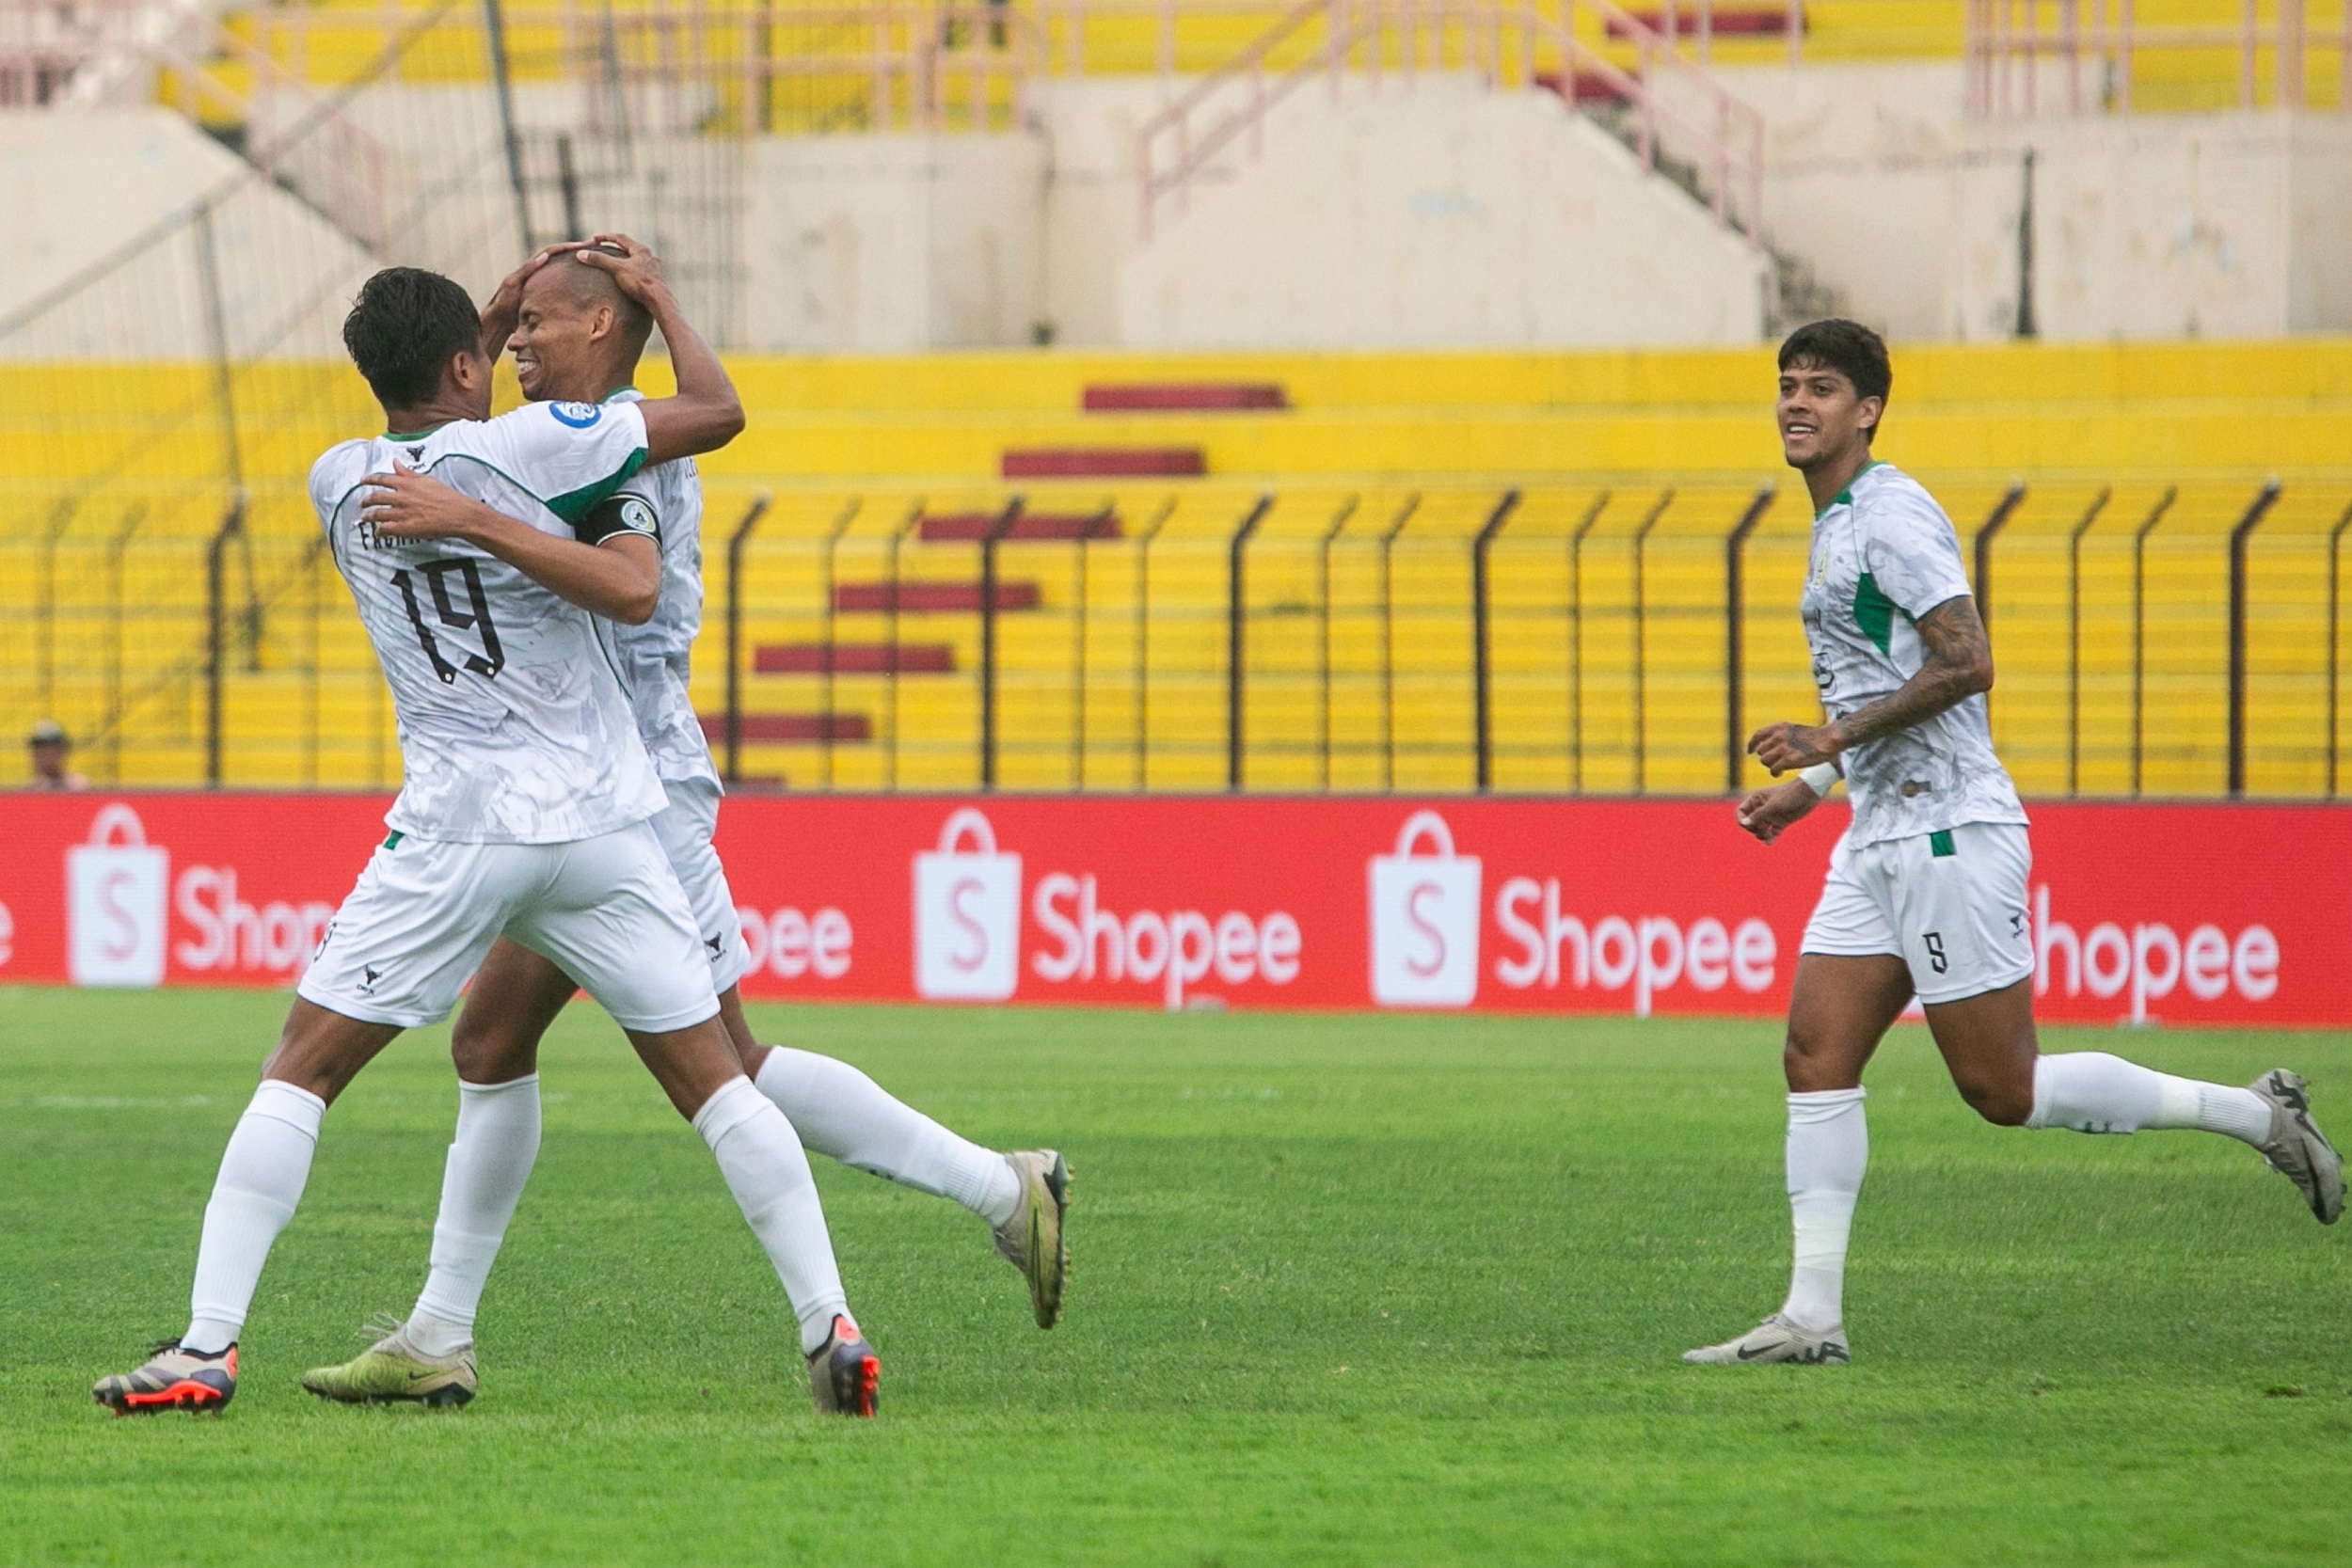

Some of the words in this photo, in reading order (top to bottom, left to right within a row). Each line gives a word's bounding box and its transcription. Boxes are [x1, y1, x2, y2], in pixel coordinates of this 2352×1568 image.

[389, 557, 505, 685] 19
[174, 865, 336, 983] Shop
[1033, 872, 1303, 1013] Shopee
[1495, 876, 1778, 1018] Shopee
[2033, 882, 2280, 1026] hopee
